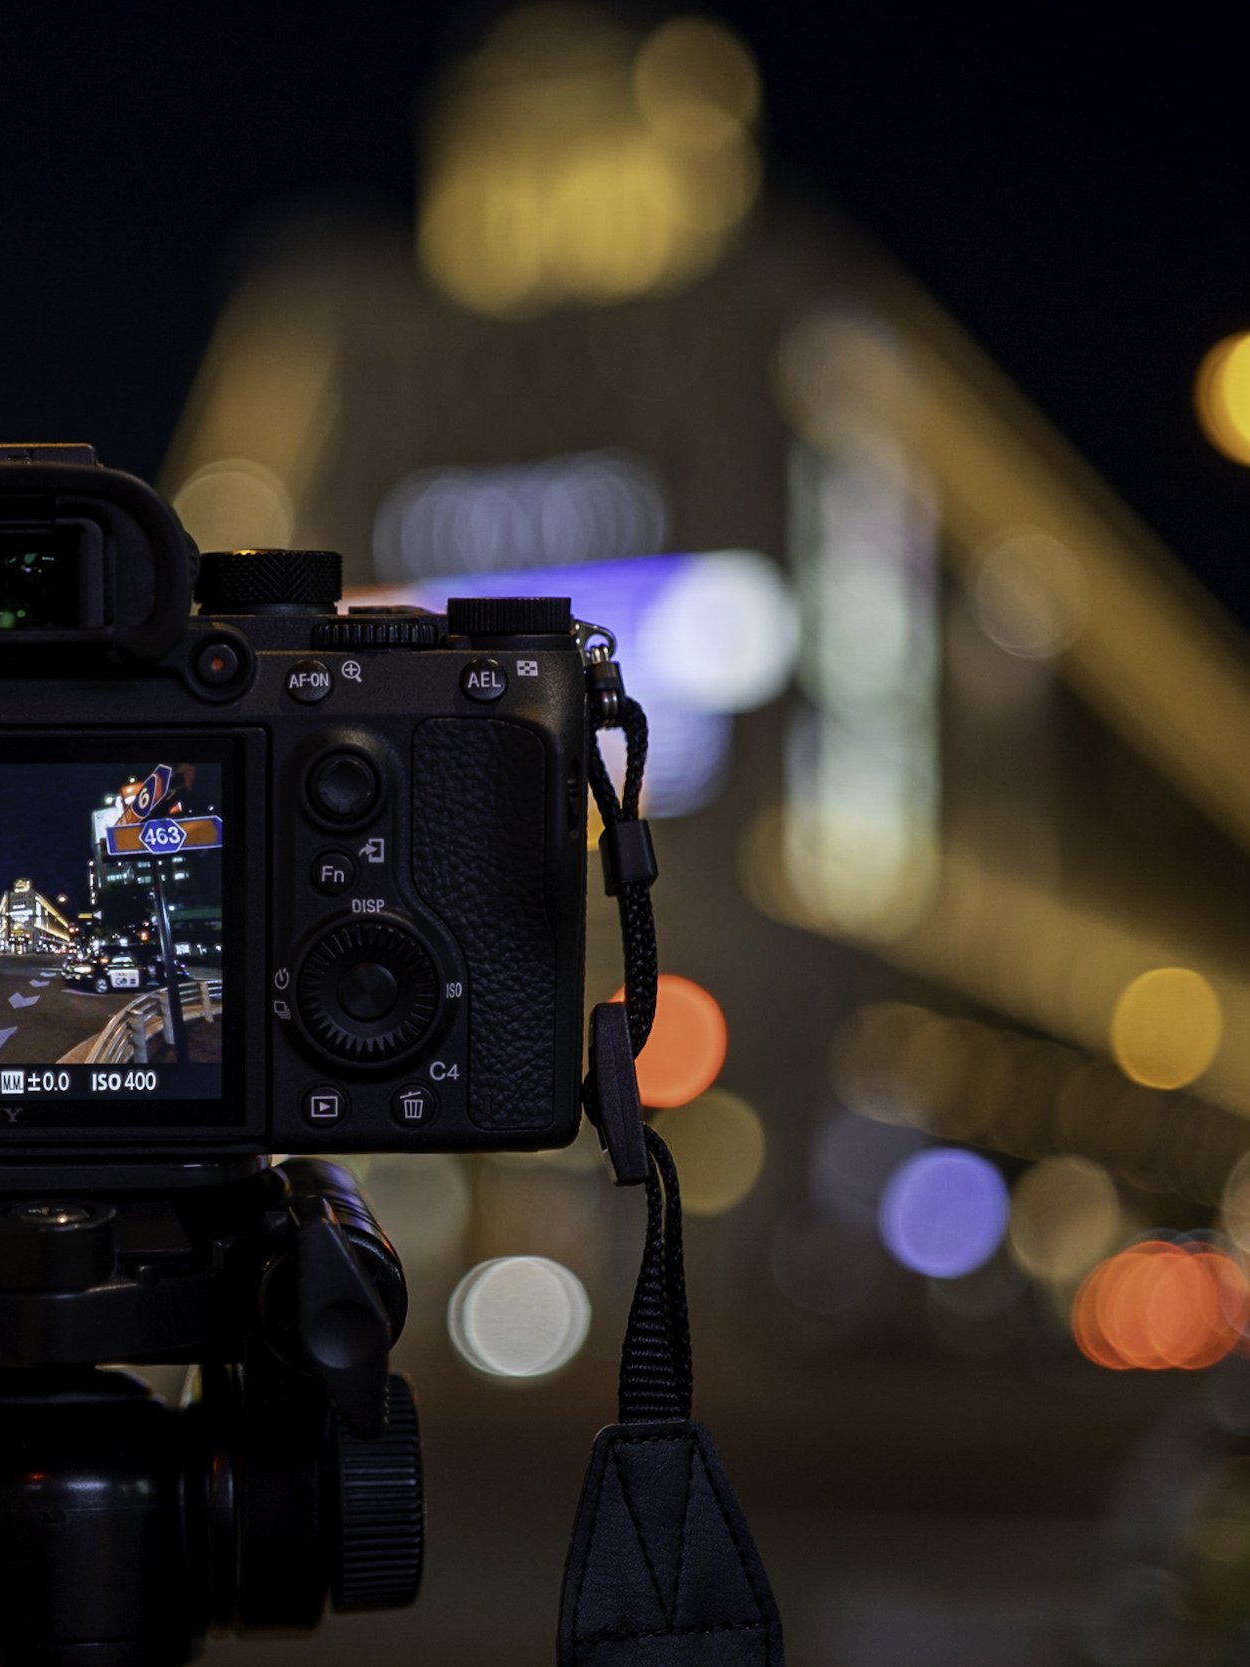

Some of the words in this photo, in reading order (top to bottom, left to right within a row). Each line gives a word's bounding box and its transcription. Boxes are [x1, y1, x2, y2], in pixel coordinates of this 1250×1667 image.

[467, 672, 502, 689] AEL
[138, 787, 150, 809] 6
[144, 825, 181, 846] 463
[321, 865, 345, 883] Fn
[352, 899, 385, 913] DISP
[446, 982, 463, 999] ISO
[429, 1061, 460, 1080] C4
[92, 1073, 121, 1092] ISO
[125, 1071, 157, 1091] 400
